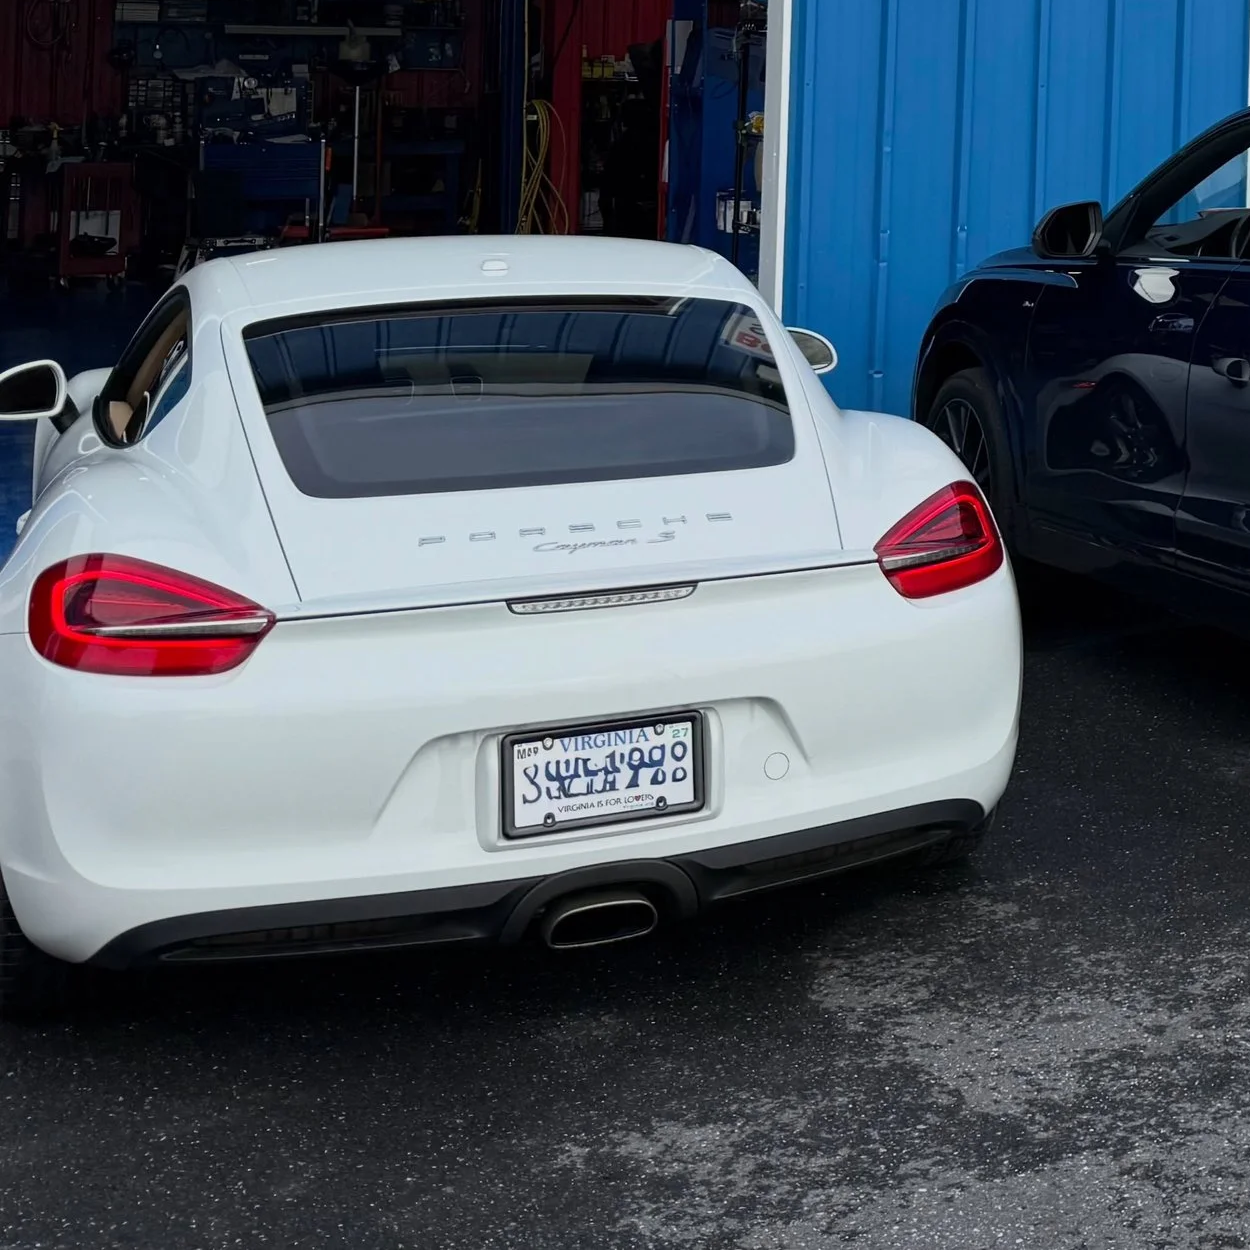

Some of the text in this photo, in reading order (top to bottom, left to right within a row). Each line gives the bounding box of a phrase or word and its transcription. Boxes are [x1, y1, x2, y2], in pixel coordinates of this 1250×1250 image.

[418, 512, 732, 547] PORSCHE
[533, 530, 675, 555] Cayman S
[560, 728, 650, 753] VIRGINIA
[672, 728, 689, 739] 27
[557, 803, 595, 813] VIRGINIA
[597, 800, 604, 808] IS
[605, 798, 622, 807] FOR
